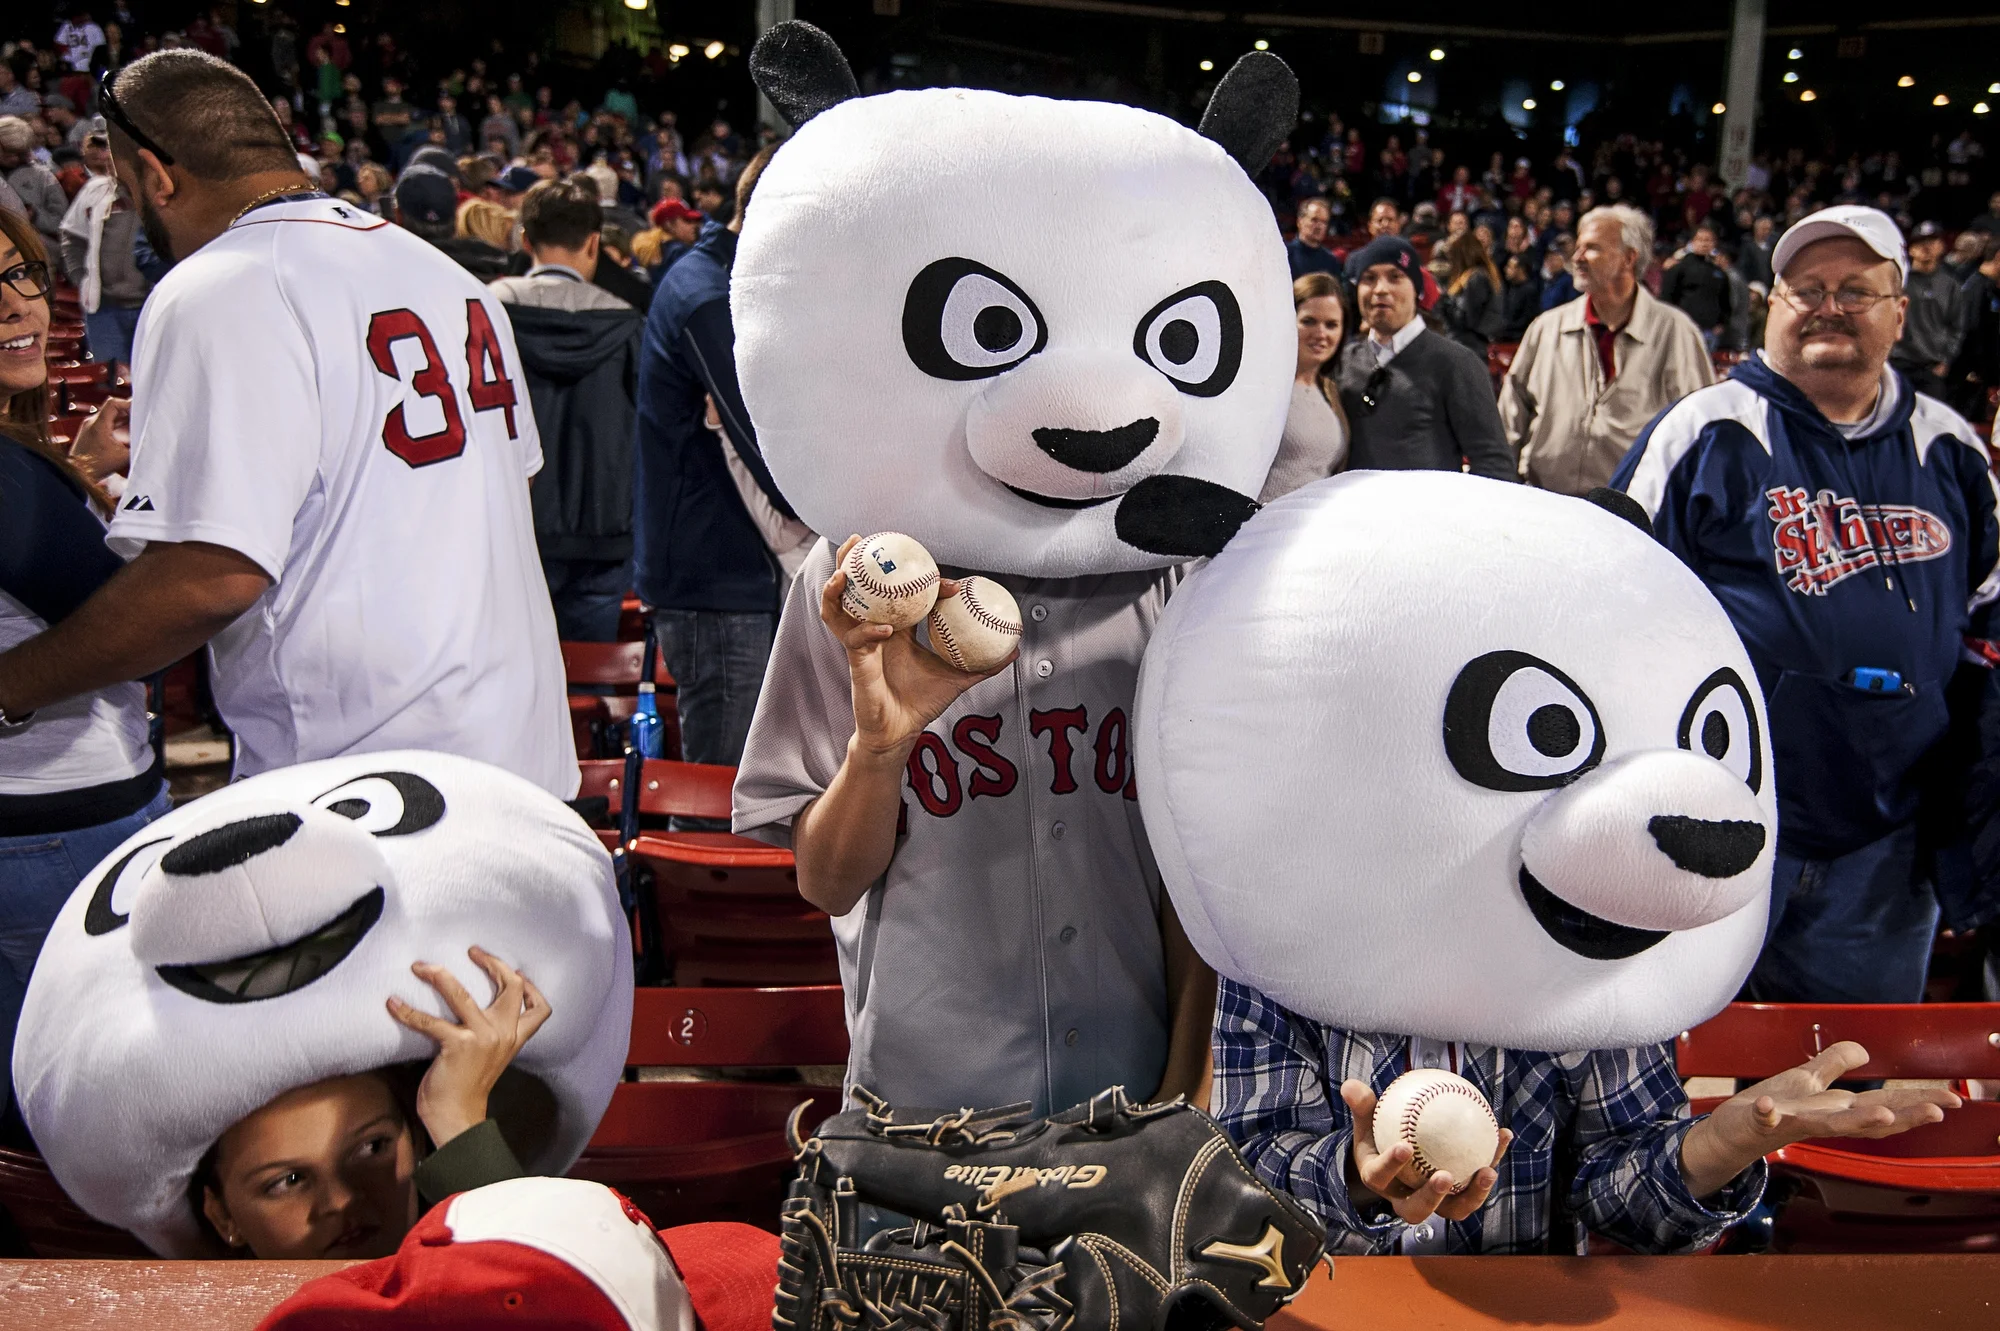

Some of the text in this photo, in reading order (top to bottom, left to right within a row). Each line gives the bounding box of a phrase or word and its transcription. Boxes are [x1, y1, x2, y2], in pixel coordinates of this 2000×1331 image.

[366, 298, 519, 469] 34
[1766, 487, 1808, 521] Jr
[896, 703, 1139, 836] OSTO
[681, 1017, 694, 1037] 2
